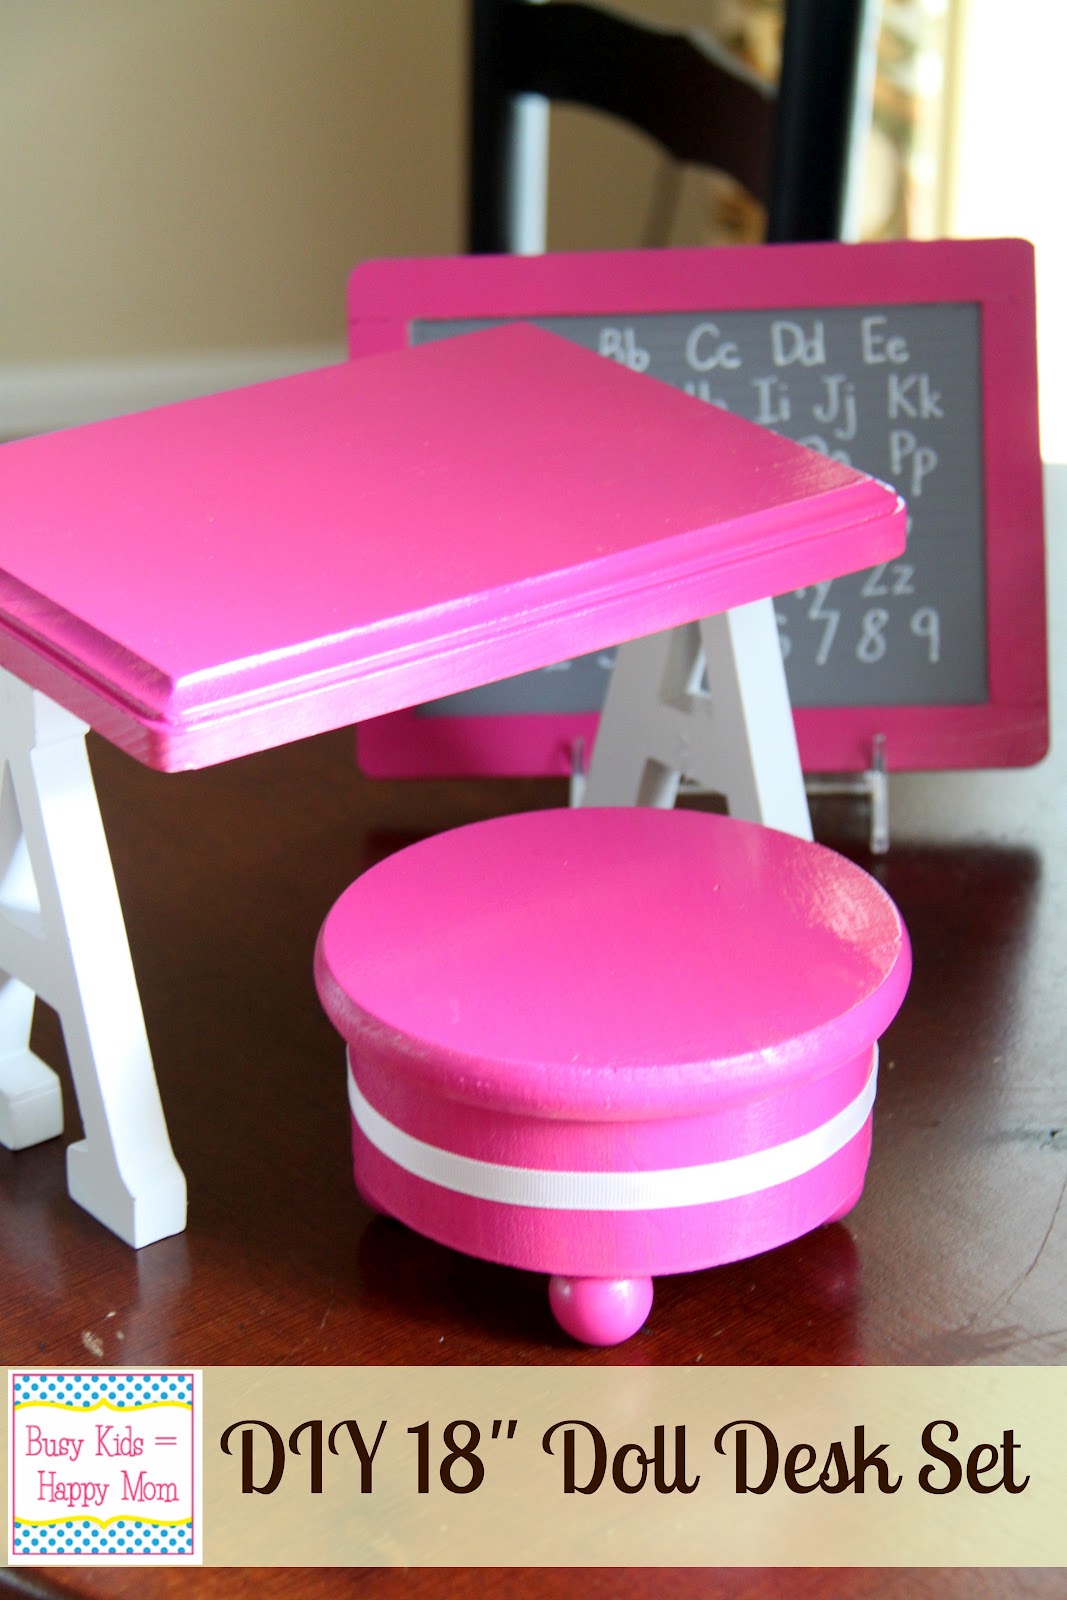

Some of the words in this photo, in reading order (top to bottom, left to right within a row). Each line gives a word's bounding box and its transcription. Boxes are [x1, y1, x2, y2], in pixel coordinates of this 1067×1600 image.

[599, 327, 650, 373] Bb
[686, 322, 742, 371] Cc
[770, 319, 826, 367] Dd
[861, 315, 910, 364] Ee
[812, 374, 858, 441] Jj
[887, 373, 944, 420] Kk
[889, 429, 938, 497] Pp
[813, 609, 841, 666] 7
[856, 607, 890, 663] 8
[910, 606, 939, 663] 9
